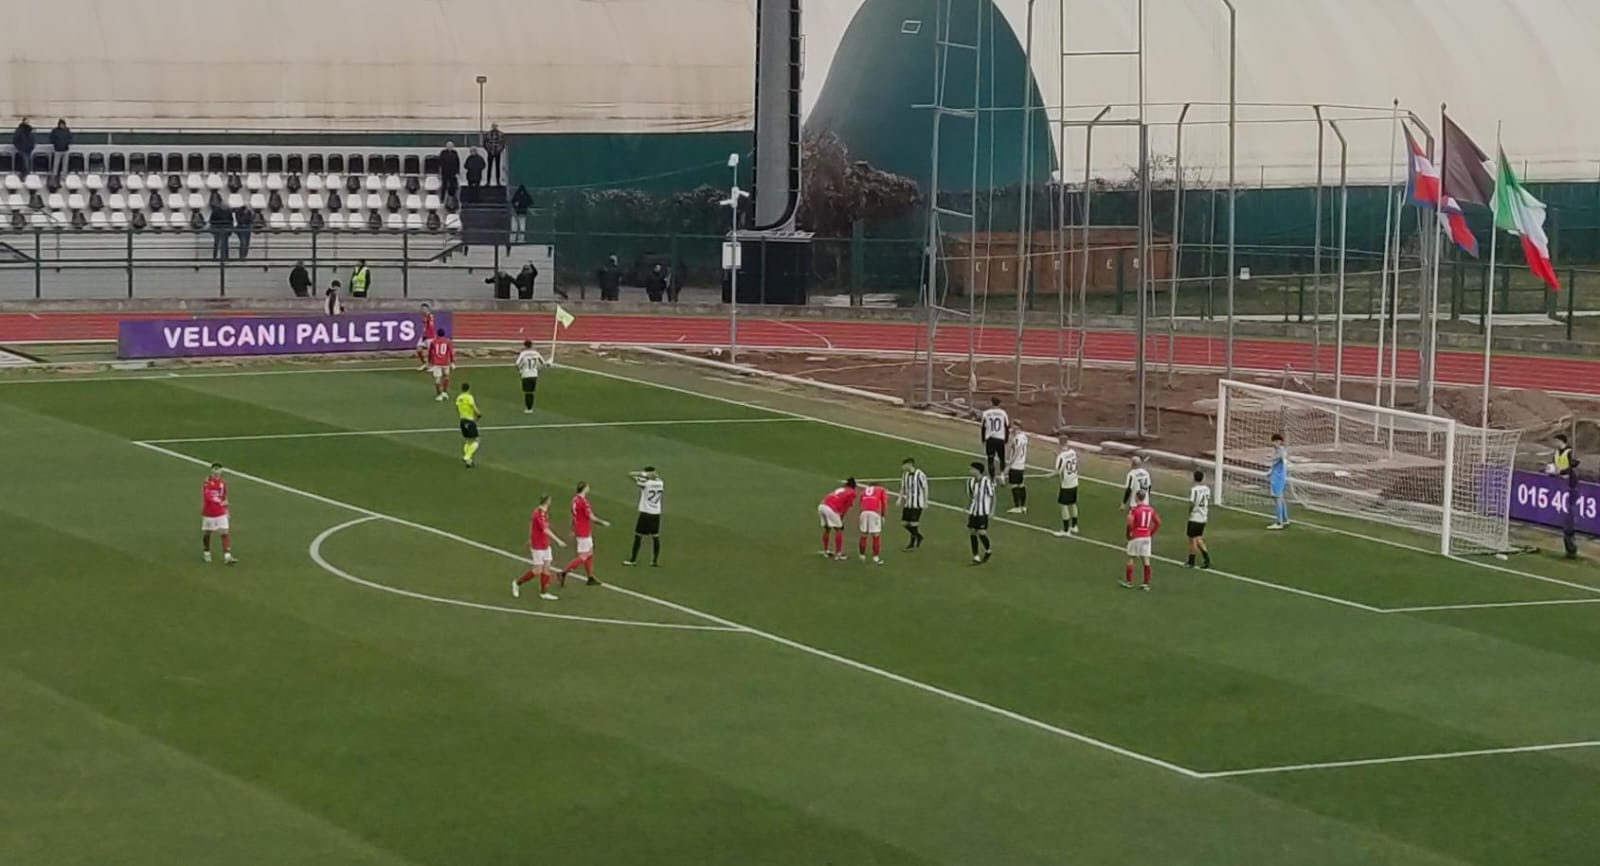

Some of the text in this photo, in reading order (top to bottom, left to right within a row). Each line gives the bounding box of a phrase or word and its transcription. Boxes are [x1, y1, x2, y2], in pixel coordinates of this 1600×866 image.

[164, 320, 416, 348] VELCANI PALLETS
[435, 343, 447, 355] 10
[989, 417, 1001, 432] 10
[648, 490, 663, 504] 27
[1518, 484, 1549, 508] 015
[1576, 495, 1596, 518] 13
[1141, 510, 1152, 527] 11
